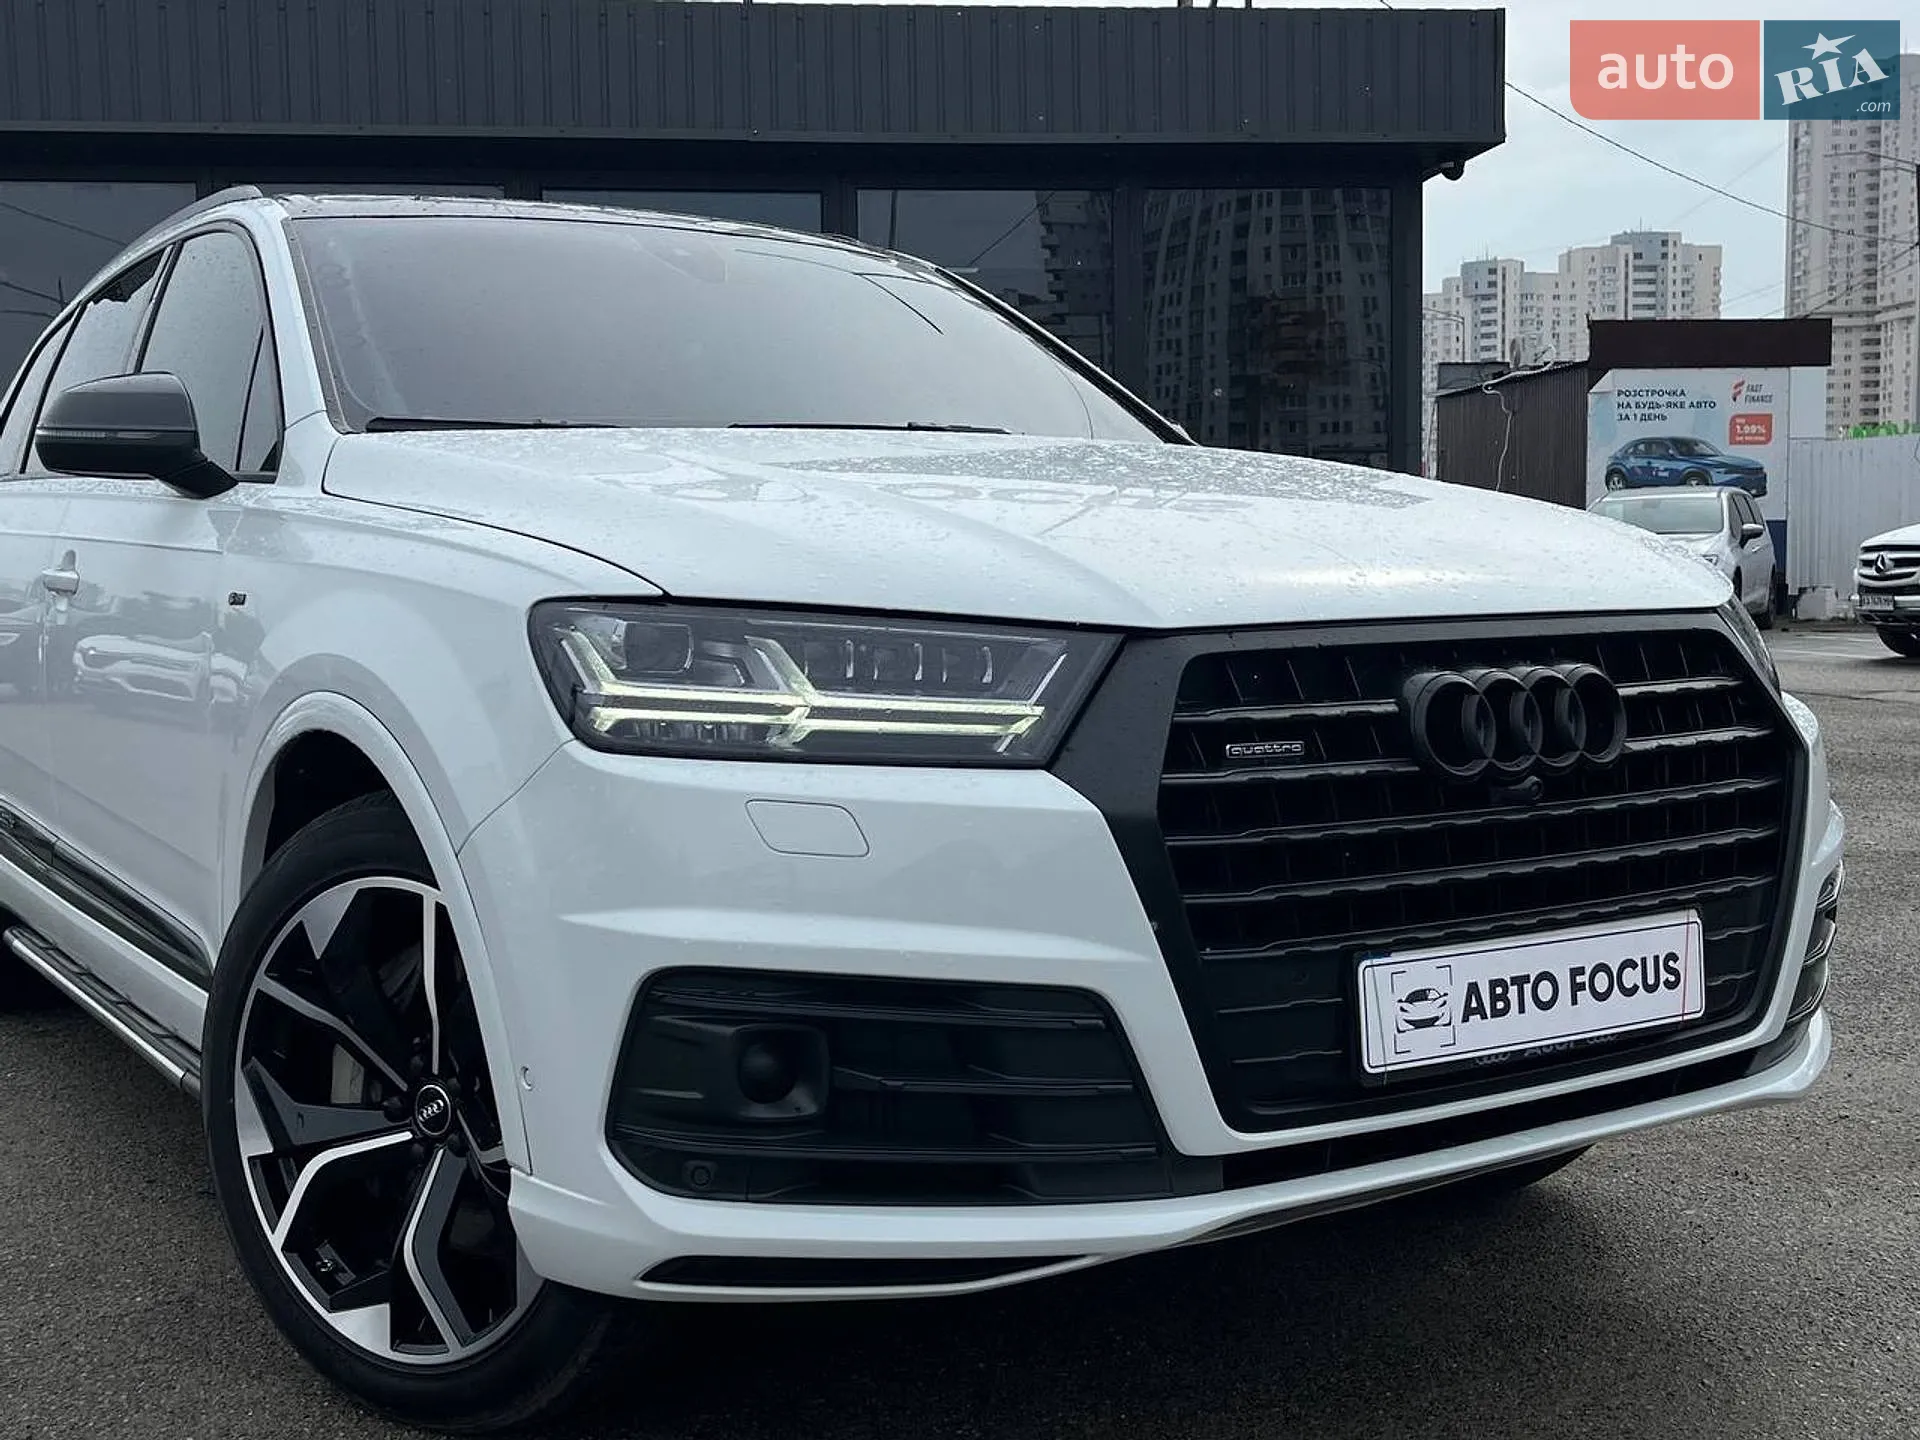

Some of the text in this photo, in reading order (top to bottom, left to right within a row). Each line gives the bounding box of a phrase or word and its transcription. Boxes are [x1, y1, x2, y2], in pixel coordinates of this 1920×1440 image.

[1617, 389, 1686, 398] РОЗСТРОЧКА
[1617, 400, 1717, 410] НА БУДЬ-ЯКЕ АВТО
[1617, 413, 1630, 422] ЗА
[1639, 413, 1668, 422] ДЕНЬ
[1231, 743, 1302, 755] quattro
[1460, 951, 1682, 1025] АВТО FOCUS
